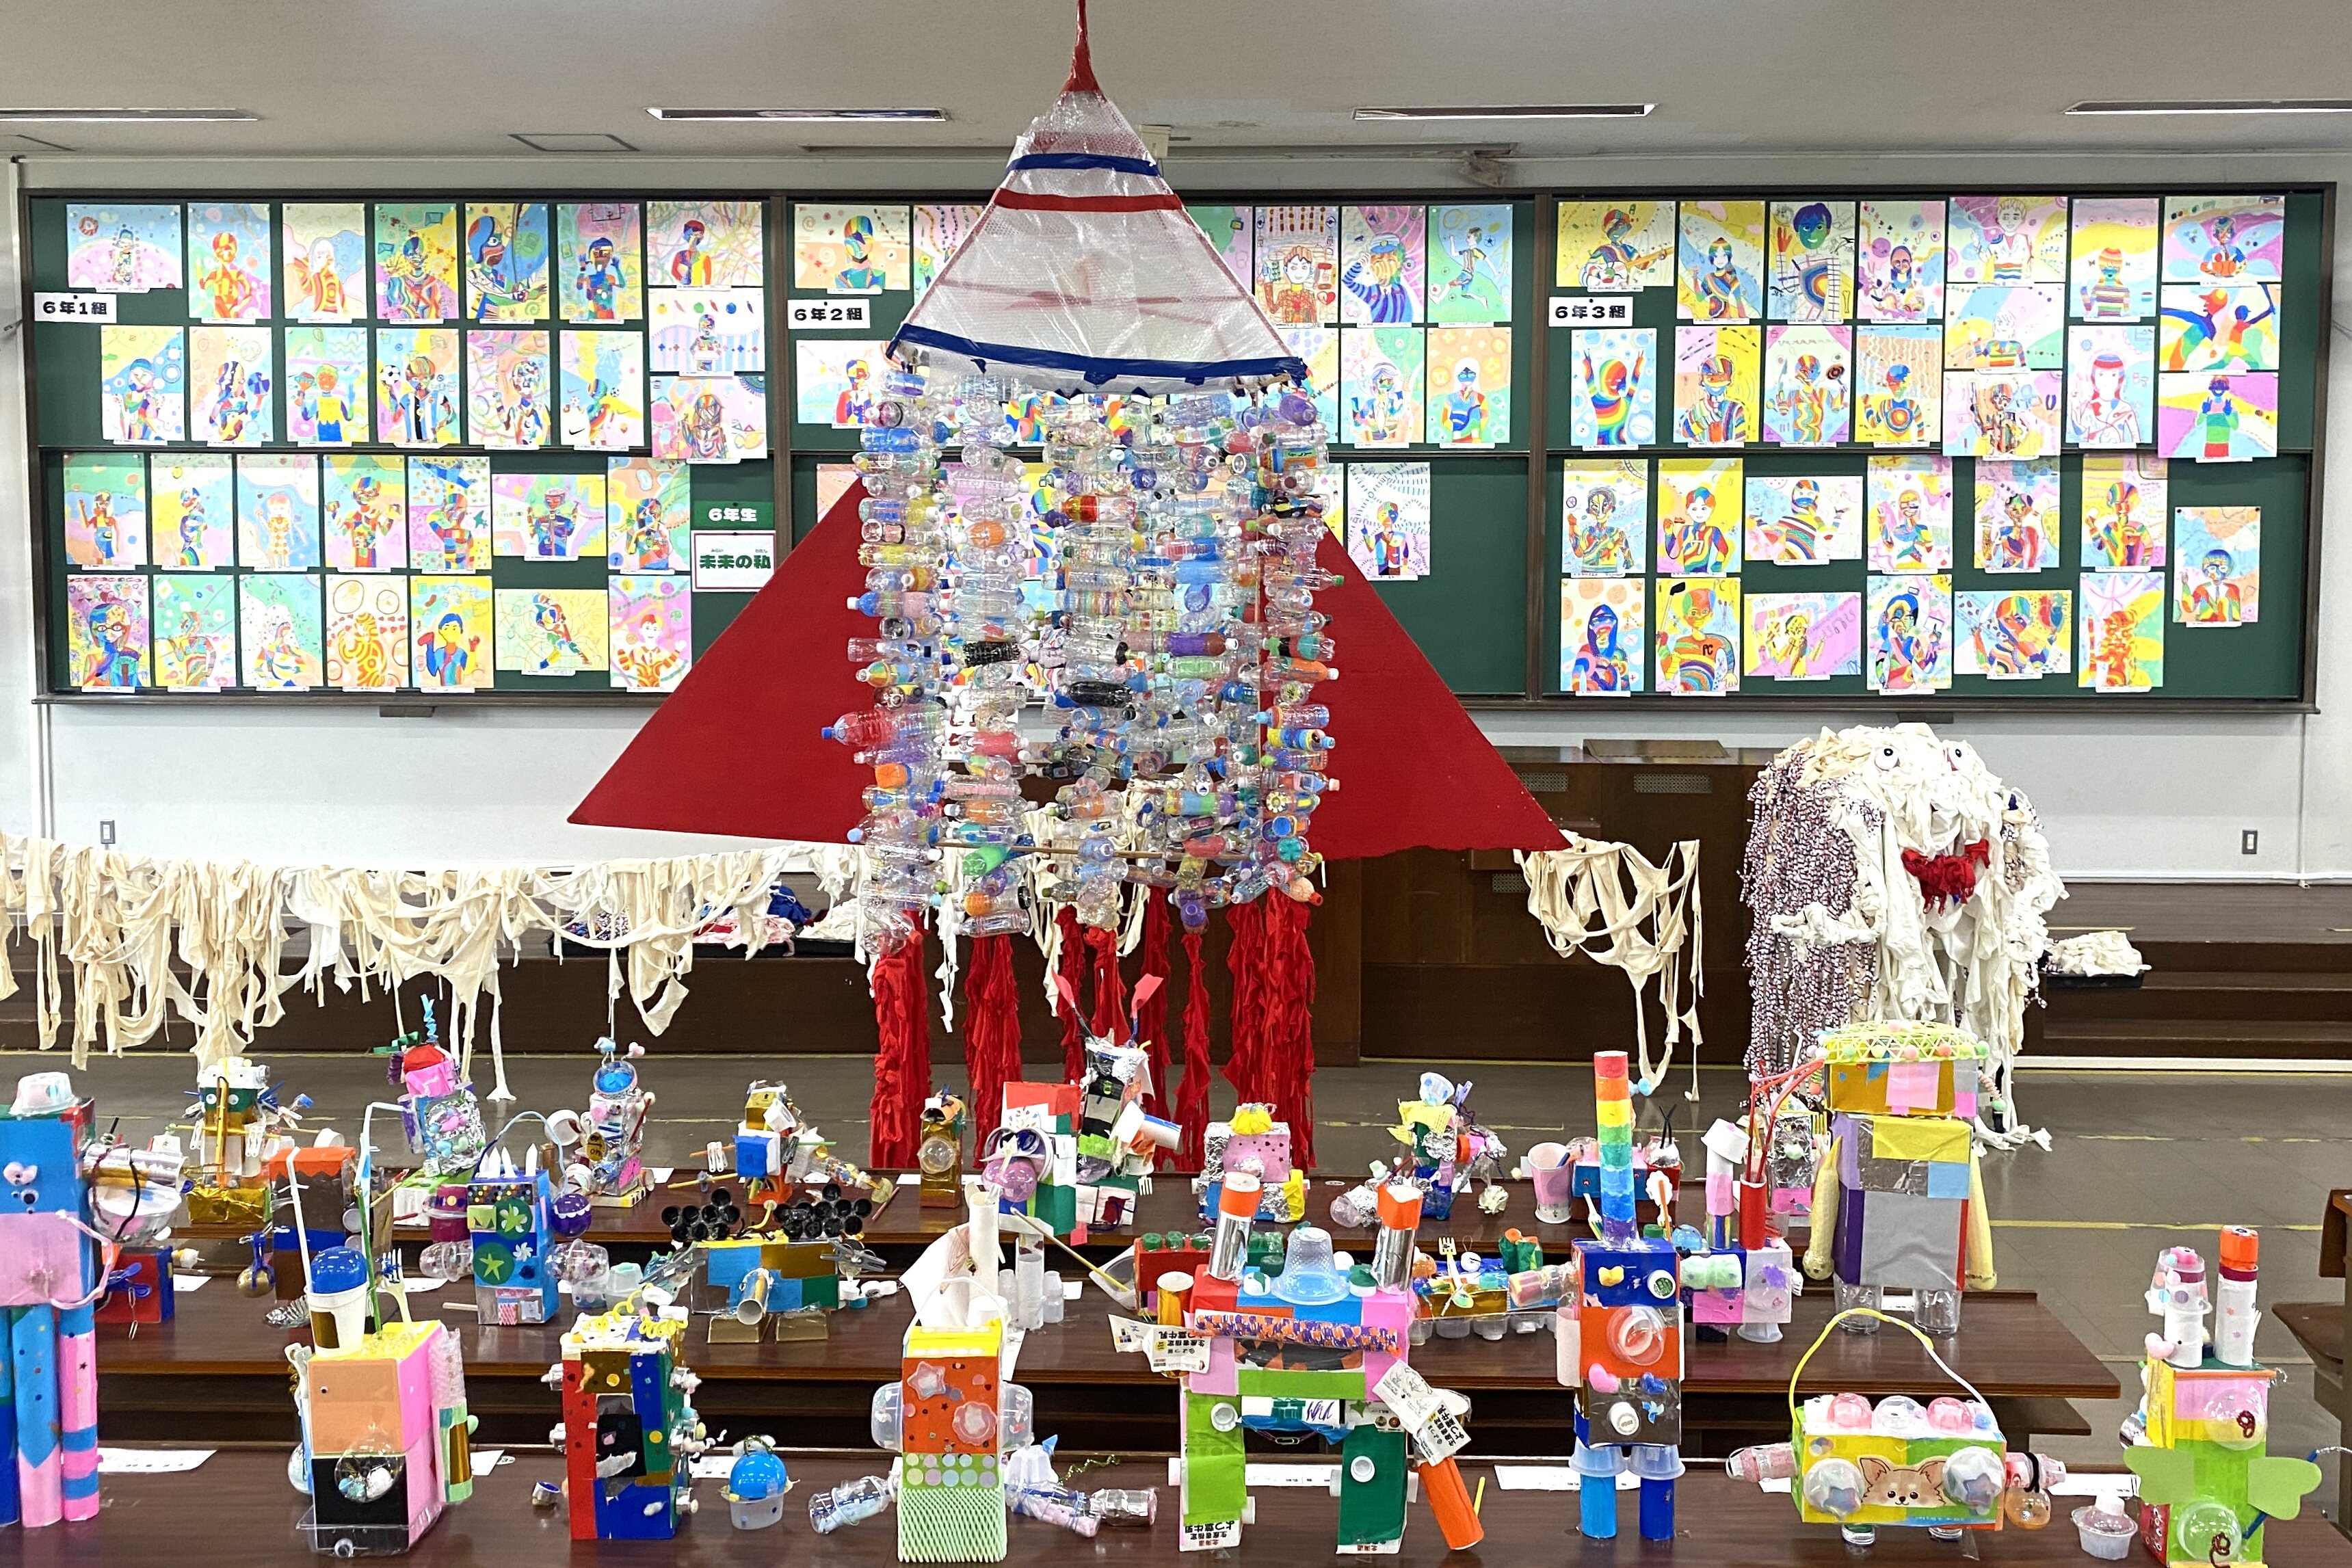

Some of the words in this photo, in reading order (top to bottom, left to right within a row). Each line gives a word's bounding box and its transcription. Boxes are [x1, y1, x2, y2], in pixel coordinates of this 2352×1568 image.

[42, 301, 107, 315] 6年1組
[794, 308, 862, 321] 6年2組
[1555, 305, 1625, 319] 6年3組
[709, 507, 757, 522] 6年生
[699, 555, 771, 569] 未来の私
[1159, 1330, 1202, 1340] つ葉牛乳
[1437, 1404, 1465, 1440] よつ葉牛乳
[1190, 1531, 1228, 1540] 生産者指定
